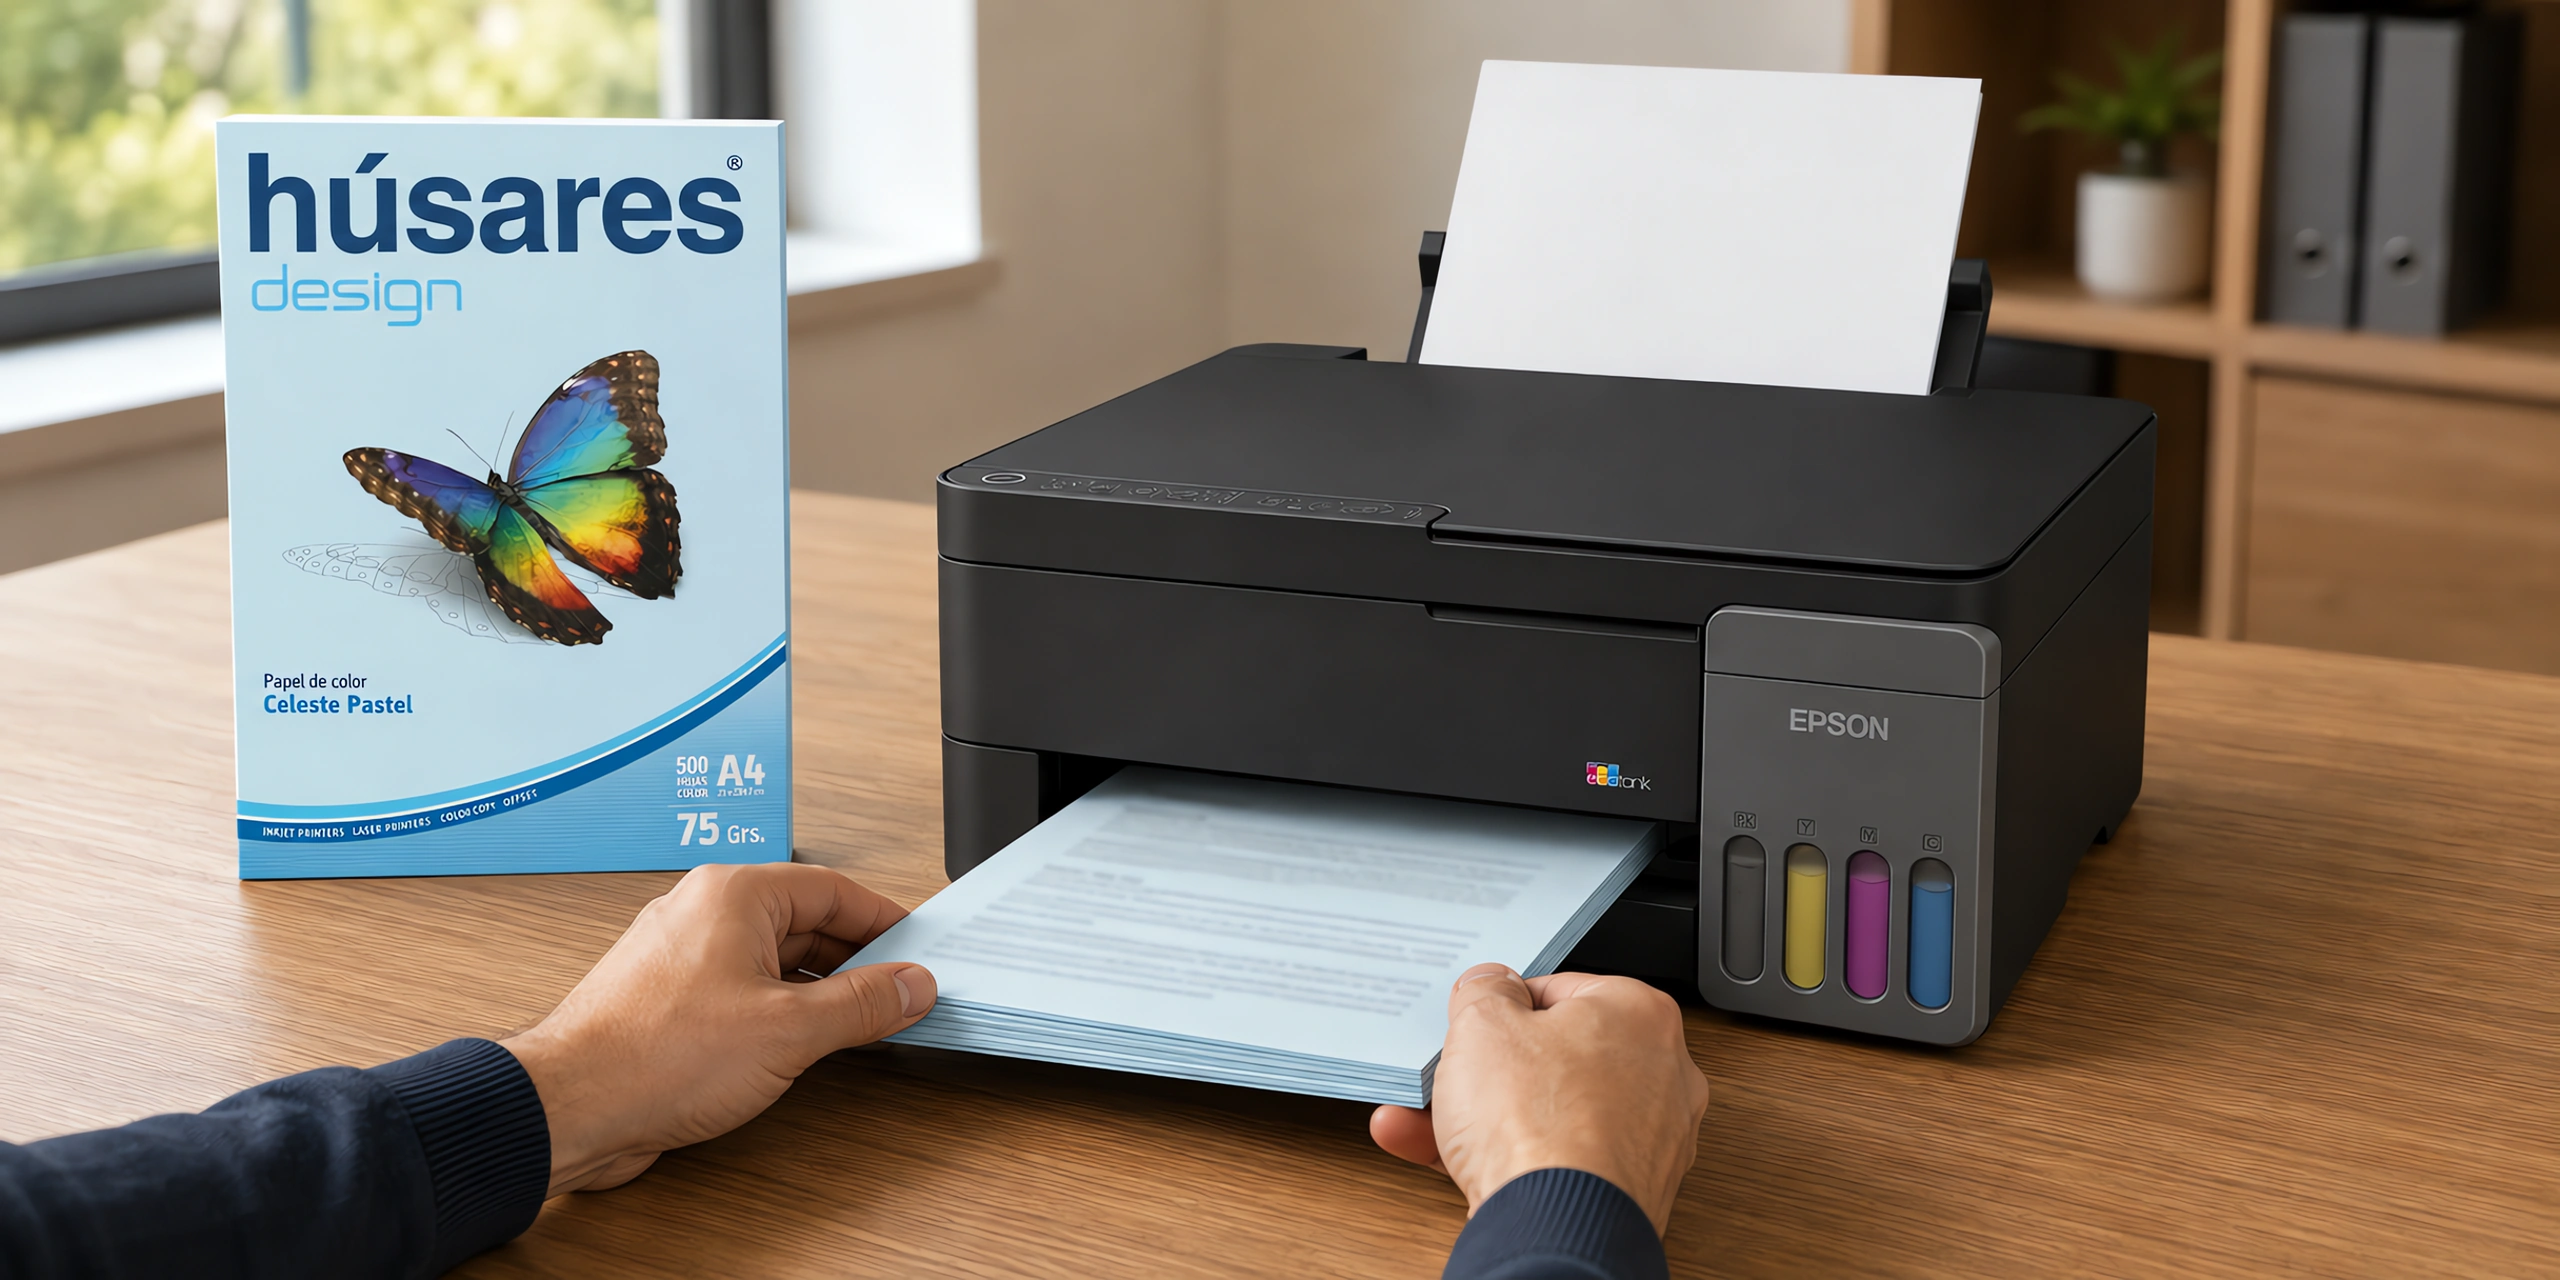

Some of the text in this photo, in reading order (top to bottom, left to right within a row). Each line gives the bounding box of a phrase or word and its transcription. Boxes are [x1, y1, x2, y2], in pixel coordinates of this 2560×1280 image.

[247, 151, 744, 255] húsares
[251, 263, 463, 327] design
[264, 673, 367, 692] Papel de color
[263, 693, 413, 714] Celeste Pastel
[1790, 708, 1889, 741] EPSON
[676, 754, 766, 786] 500 A4
[677, 811, 765, 847] 75 Grs.
